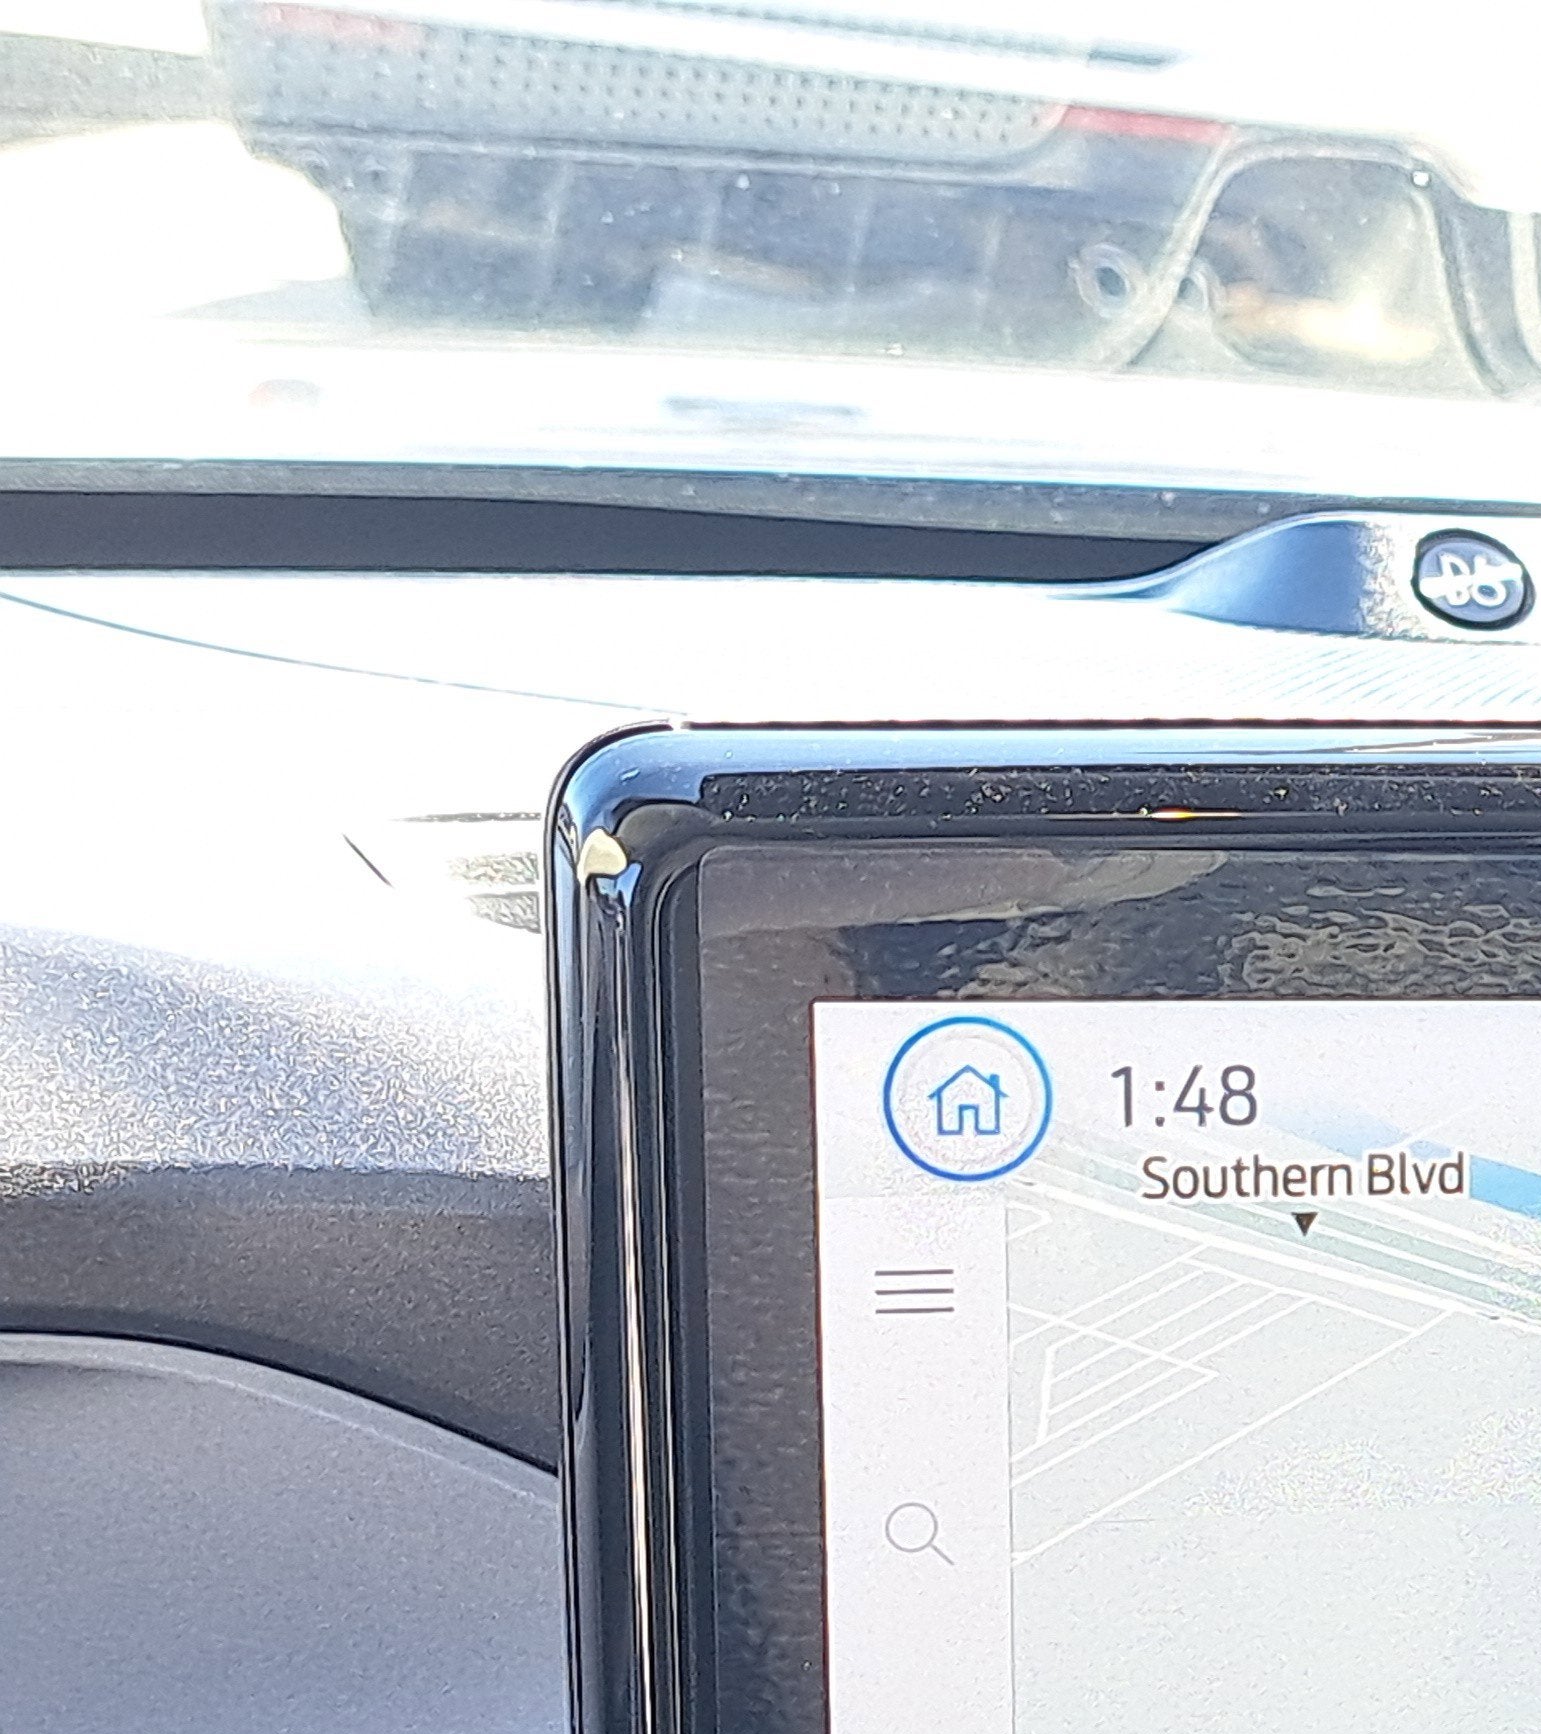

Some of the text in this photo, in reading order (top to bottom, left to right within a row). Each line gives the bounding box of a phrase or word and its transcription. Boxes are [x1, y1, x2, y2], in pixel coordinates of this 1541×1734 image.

[1110, 1065, 1259, 1127] 1:48
[1142, 1152, 1465, 1200] Southern Blvd
